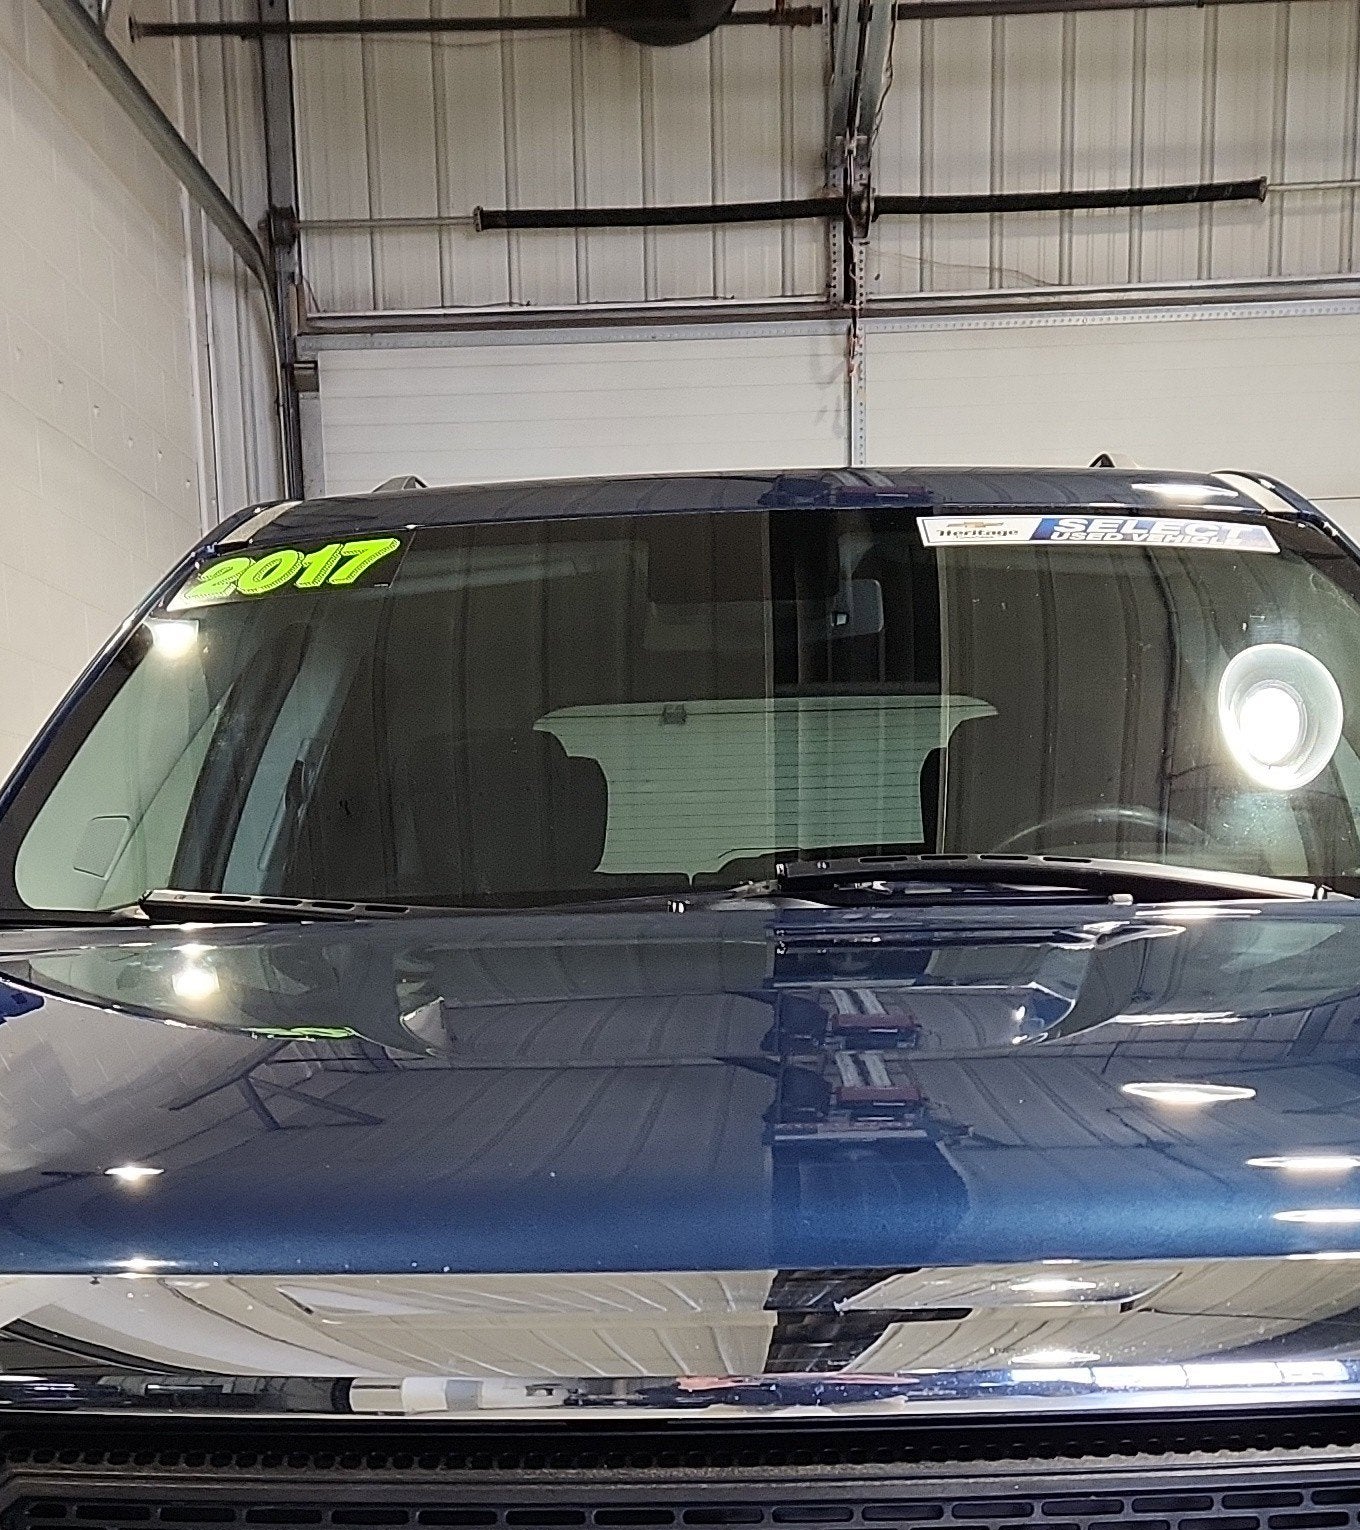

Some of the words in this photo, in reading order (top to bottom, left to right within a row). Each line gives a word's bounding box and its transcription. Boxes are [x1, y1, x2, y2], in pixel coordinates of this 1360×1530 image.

[1050, 531, 1123, 541] USED
[1053, 518, 1254, 538] SELECT
[185, 538, 401, 599] 2017
